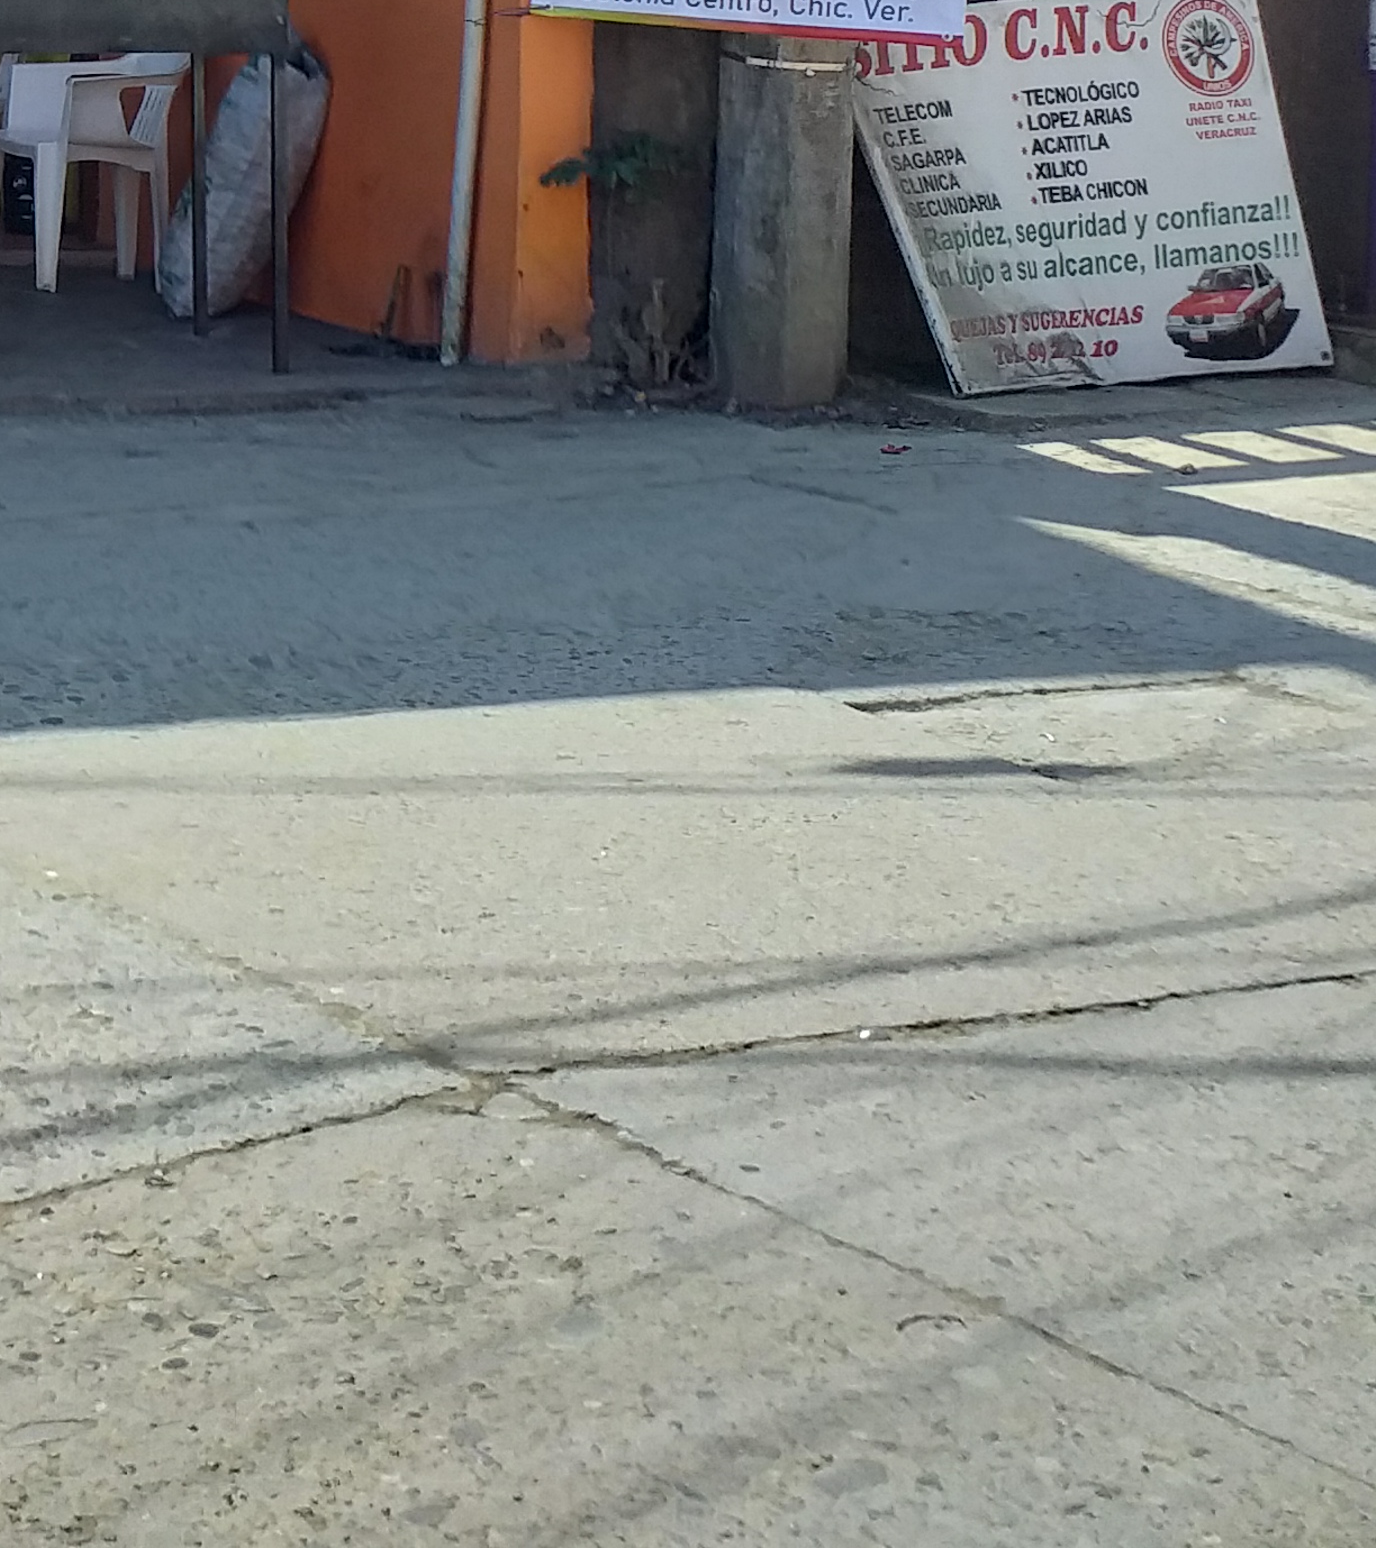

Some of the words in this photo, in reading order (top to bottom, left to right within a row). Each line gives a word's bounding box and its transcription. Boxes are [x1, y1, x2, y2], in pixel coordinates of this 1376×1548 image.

[1004, 0, 1150, 59] C.N.C.
[1167, 0, 1202, 57] CAMPESINOS
[1203, 1, 1218, 11] DE
[1021, 79, 1140, 106] TECNOLÓGICO
[1189, 99, 1224, 112] RADIO
[1227, 98, 1252, 109] TAXI
[873, 100, 953, 125] TELECOM
[1027, 109, 1079, 131] LOPEZ
[1083, 105, 1133, 126] ARIAS
[1186, 114, 1225, 127] UNETE
[1227, 111, 1262, 124] C.N.C.
[883, 128, 927, 148] C.F.E.
[1031, 133, 1110, 156] ACATITLA
[1196, 126, 1258, 141] VERACRUZ
[890, 147, 967, 172] SAGARPA
[1034, 159, 1088, 181] XILICO
[899, 173, 961, 195] CLINICA
[1037, 184, 1084, 205] TEBA
[1086, 178, 1149, 201] CHICON
[907, 192, 1003, 219] SECUNDARIA
[923, 220, 1013, 256] Rapidez,
[1015, 209, 1127, 248] seguridad
[1134, 212, 1148, 240] y
[1156, 195, 1293, 232] confianza!!
[1000, 261, 1013, 283] a
[1017, 259, 1038, 281] su
[1043, 248, 1146, 280] alcance,
[1154, 233, 1300, 270] llamanos!!!
[950, 313, 1006, 342] QUEJAS
[1006, 312, 1018, 334] Y
[1021, 304, 1145, 332] SUGERENCIAS
[1090, 339, 1119, 358] 10
